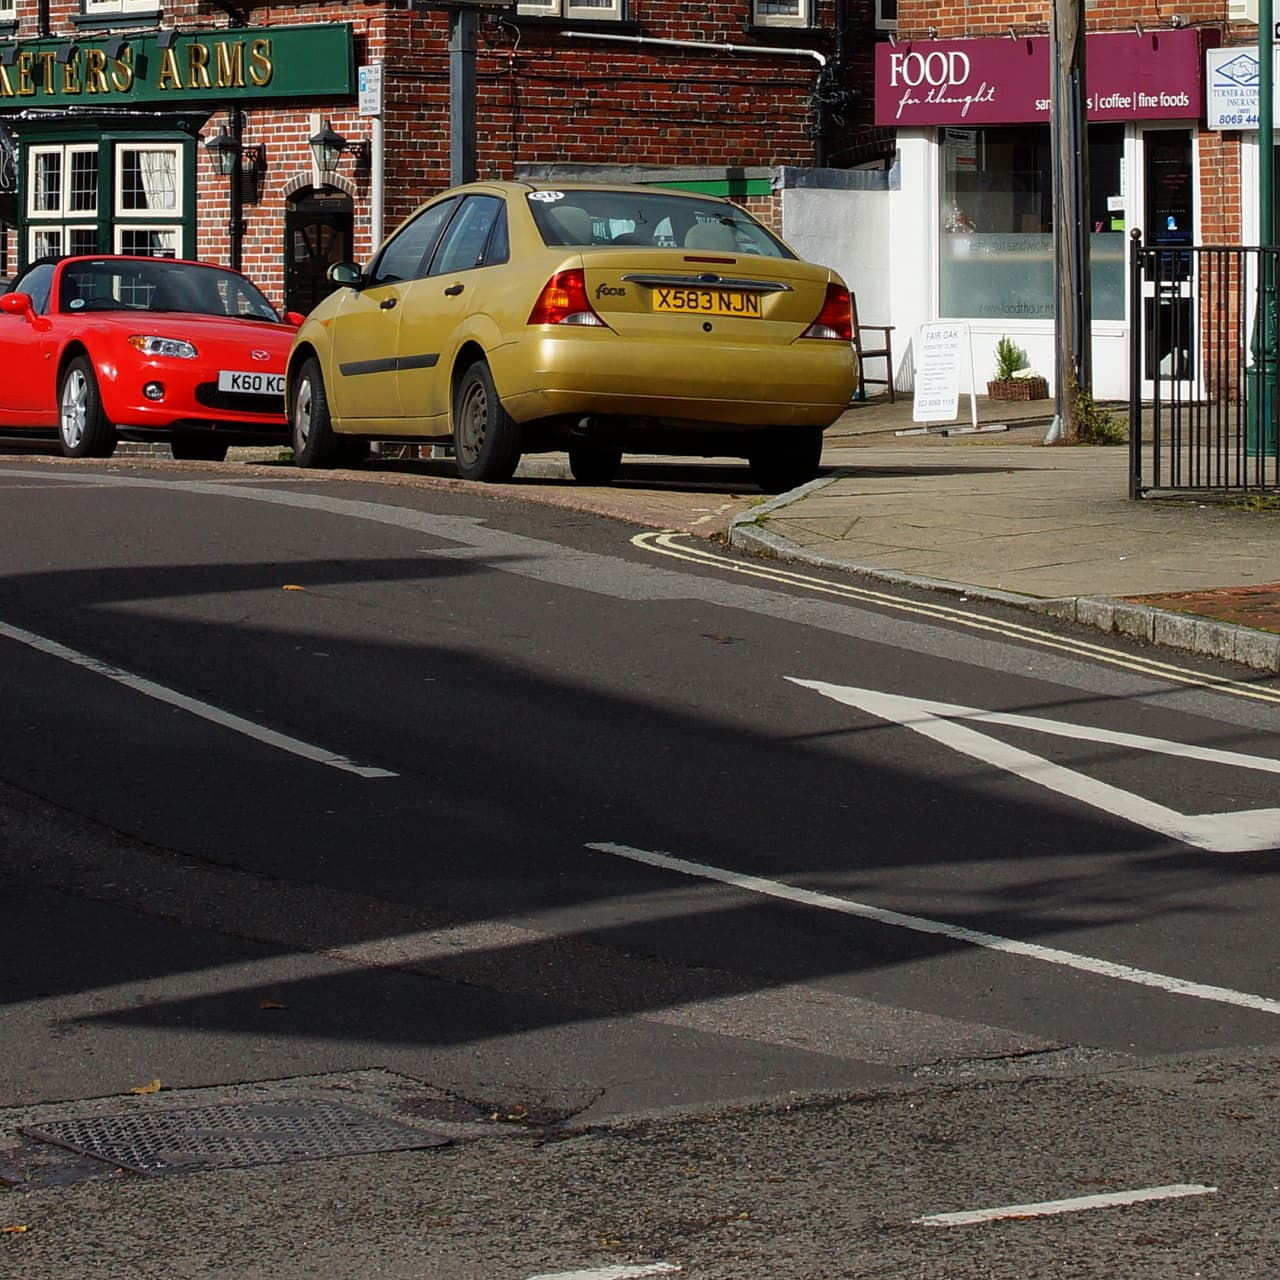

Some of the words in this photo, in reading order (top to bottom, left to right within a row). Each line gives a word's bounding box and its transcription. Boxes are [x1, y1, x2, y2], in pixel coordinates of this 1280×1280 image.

[159, 38, 274, 89] ARMS
[890, 51, 970, 87] FOOD
[895, 87, 921, 119] for
[923, 81, 996, 117] thought
[1099, 92, 1131, 108] coffee
[1138, 92, 1157, 108] fine
[1159, 90, 1190, 107] foods
[1213, 89, 1238, 97] TURNER
[1239, 89, 1245, 97] &
[1245, 88, 1259, 97] COM
[1226, 98, 1258, 107] INSURANC
[1219, 114, 1243, 124] 8069
[1246, 114, 1260, 124] 44
[533, 191, 563, 201] GB
[595, 283, 626, 299] focus
[657, 289, 713, 311] X583
[717, 293, 759, 313] NJN
[231, 375, 262, 391] K60
[266, 377, 286, 393] KC
